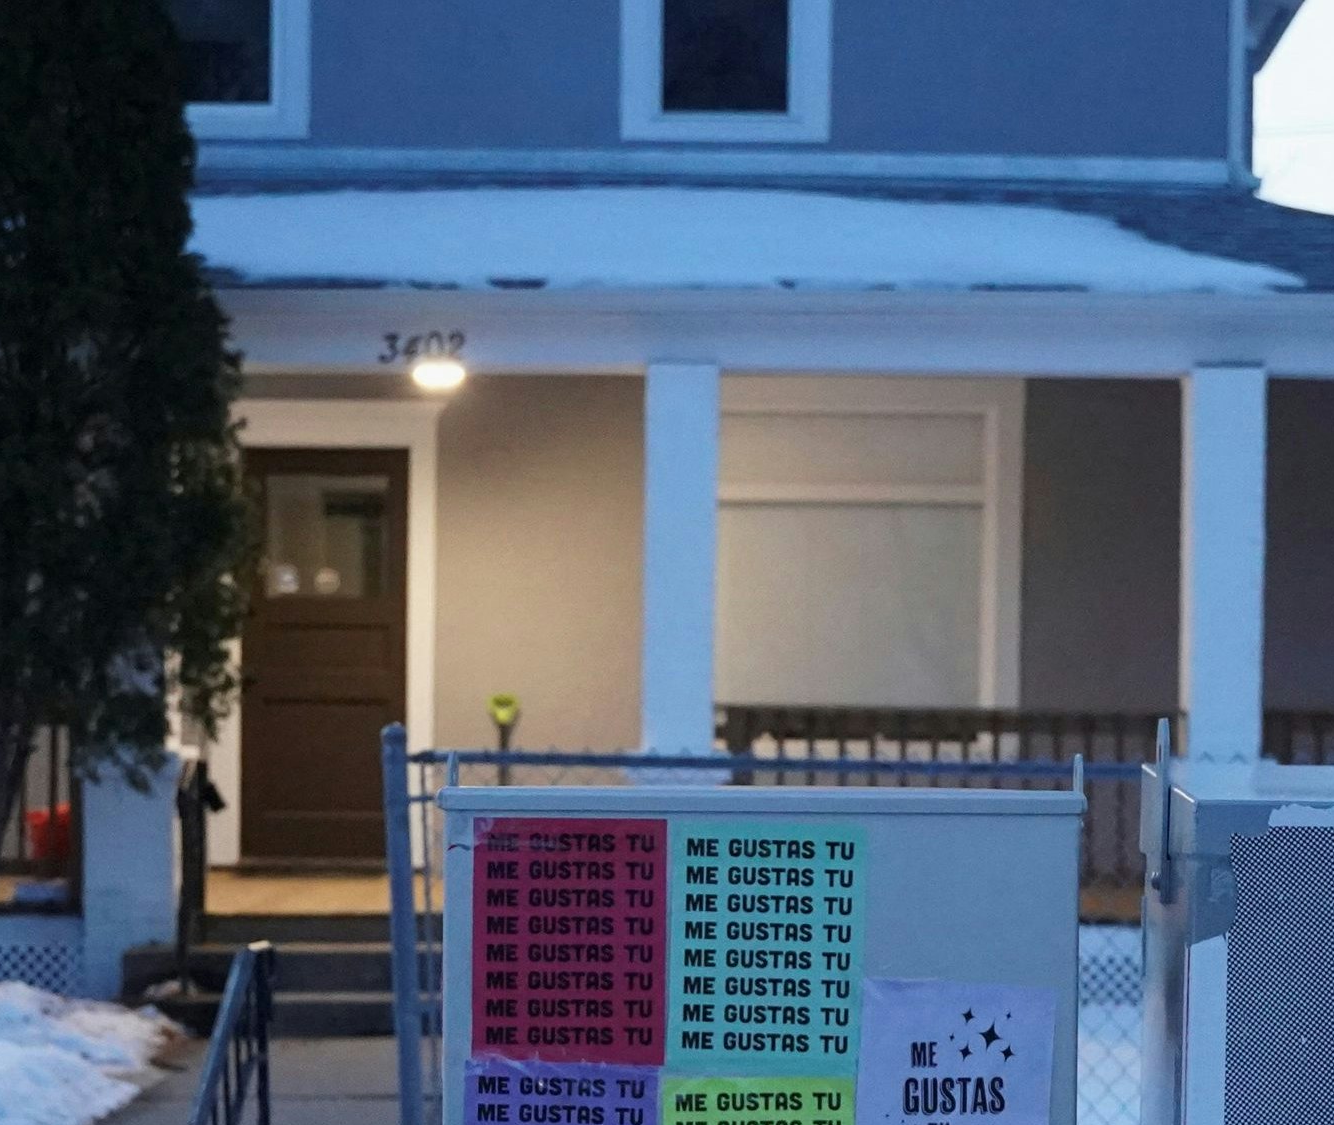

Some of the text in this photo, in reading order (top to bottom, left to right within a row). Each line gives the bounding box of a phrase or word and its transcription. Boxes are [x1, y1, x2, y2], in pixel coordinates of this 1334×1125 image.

[486, 832, 656, 854] ME GUSTAS TU
[686, 837, 855, 861] ME GUSTAS TU
[486, 859, 654, 881] ME GUSTAS TU
[686, 865, 854, 889] ME GUSTAS TU
[485, 887, 655, 909] ME GUSTAS TU
[685, 893, 853, 916] ME GUSTAS TU
[486, 915, 655, 936] ME GUSTAS TU
[684, 920, 852, 944] ME GUSTAS TU
[485, 943, 654, 964] ME GUSTAS TU
[683, 948, 851, 972] ME GUSTAS TU
[485, 970, 654, 992] ME GUSTAS TU
[683, 975, 850, 999] ME GUSTAS TU
[484, 998, 653, 1019] ME GUSTAS TU
[682, 1003, 849, 1027] ME GUSTAS TU
[485, 1025, 653, 1047] ME GUSTAS TU
[681, 1030, 848, 1055] ME GUSTAS TU
[910, 1041, 939, 1068] ME
[477, 1075, 646, 1100] ME GUSTAS TU
[902, 1076, 1006, 1116] GUSTAS
[477, 1103, 510, 1123] ME
[518, 1103, 605, 1125] GUSTAS
[675, 1092, 842, 1113] ME GUSTAS TU
